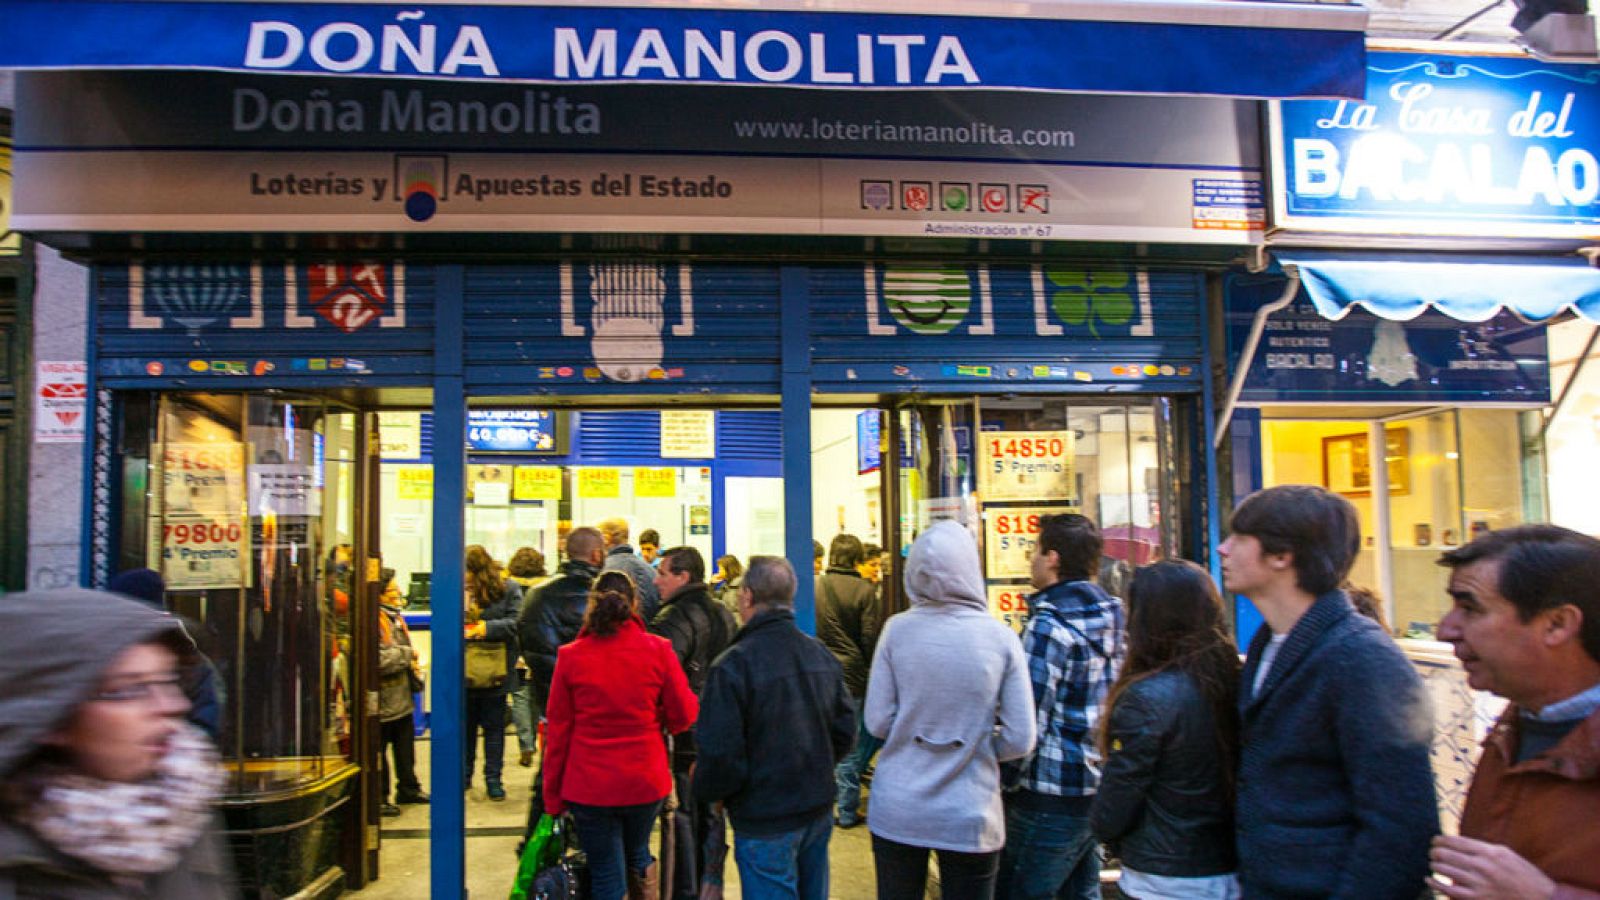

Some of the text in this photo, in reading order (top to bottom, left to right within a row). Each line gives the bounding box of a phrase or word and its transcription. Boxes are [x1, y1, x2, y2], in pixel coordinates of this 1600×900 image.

[245, 10, 981, 84] DOÑA MANOLITA
[233, 87, 601, 135] Doña Manolita
[1389, 82, 1497, 135] Casa
[1507, 91, 1576, 138] del
[734, 117, 1075, 147] www.loteriamanolita.com
[1293, 136, 1600, 207] BACALAO
[251, 172, 388, 201] Loterías y
[454, 172, 733, 201] Apuestas del Estado
[924, 223, 1017, 236] Administración
[1037, 226, 1052, 237] 67
[1266, 353, 1334, 370] BACALAO
[991, 438, 1064, 458] 14850
[1012, 461, 1062, 473] Premio
[163, 524, 241, 544] 79800
[997, 515, 1041, 534] 818
[181, 547, 238, 560] Premio
